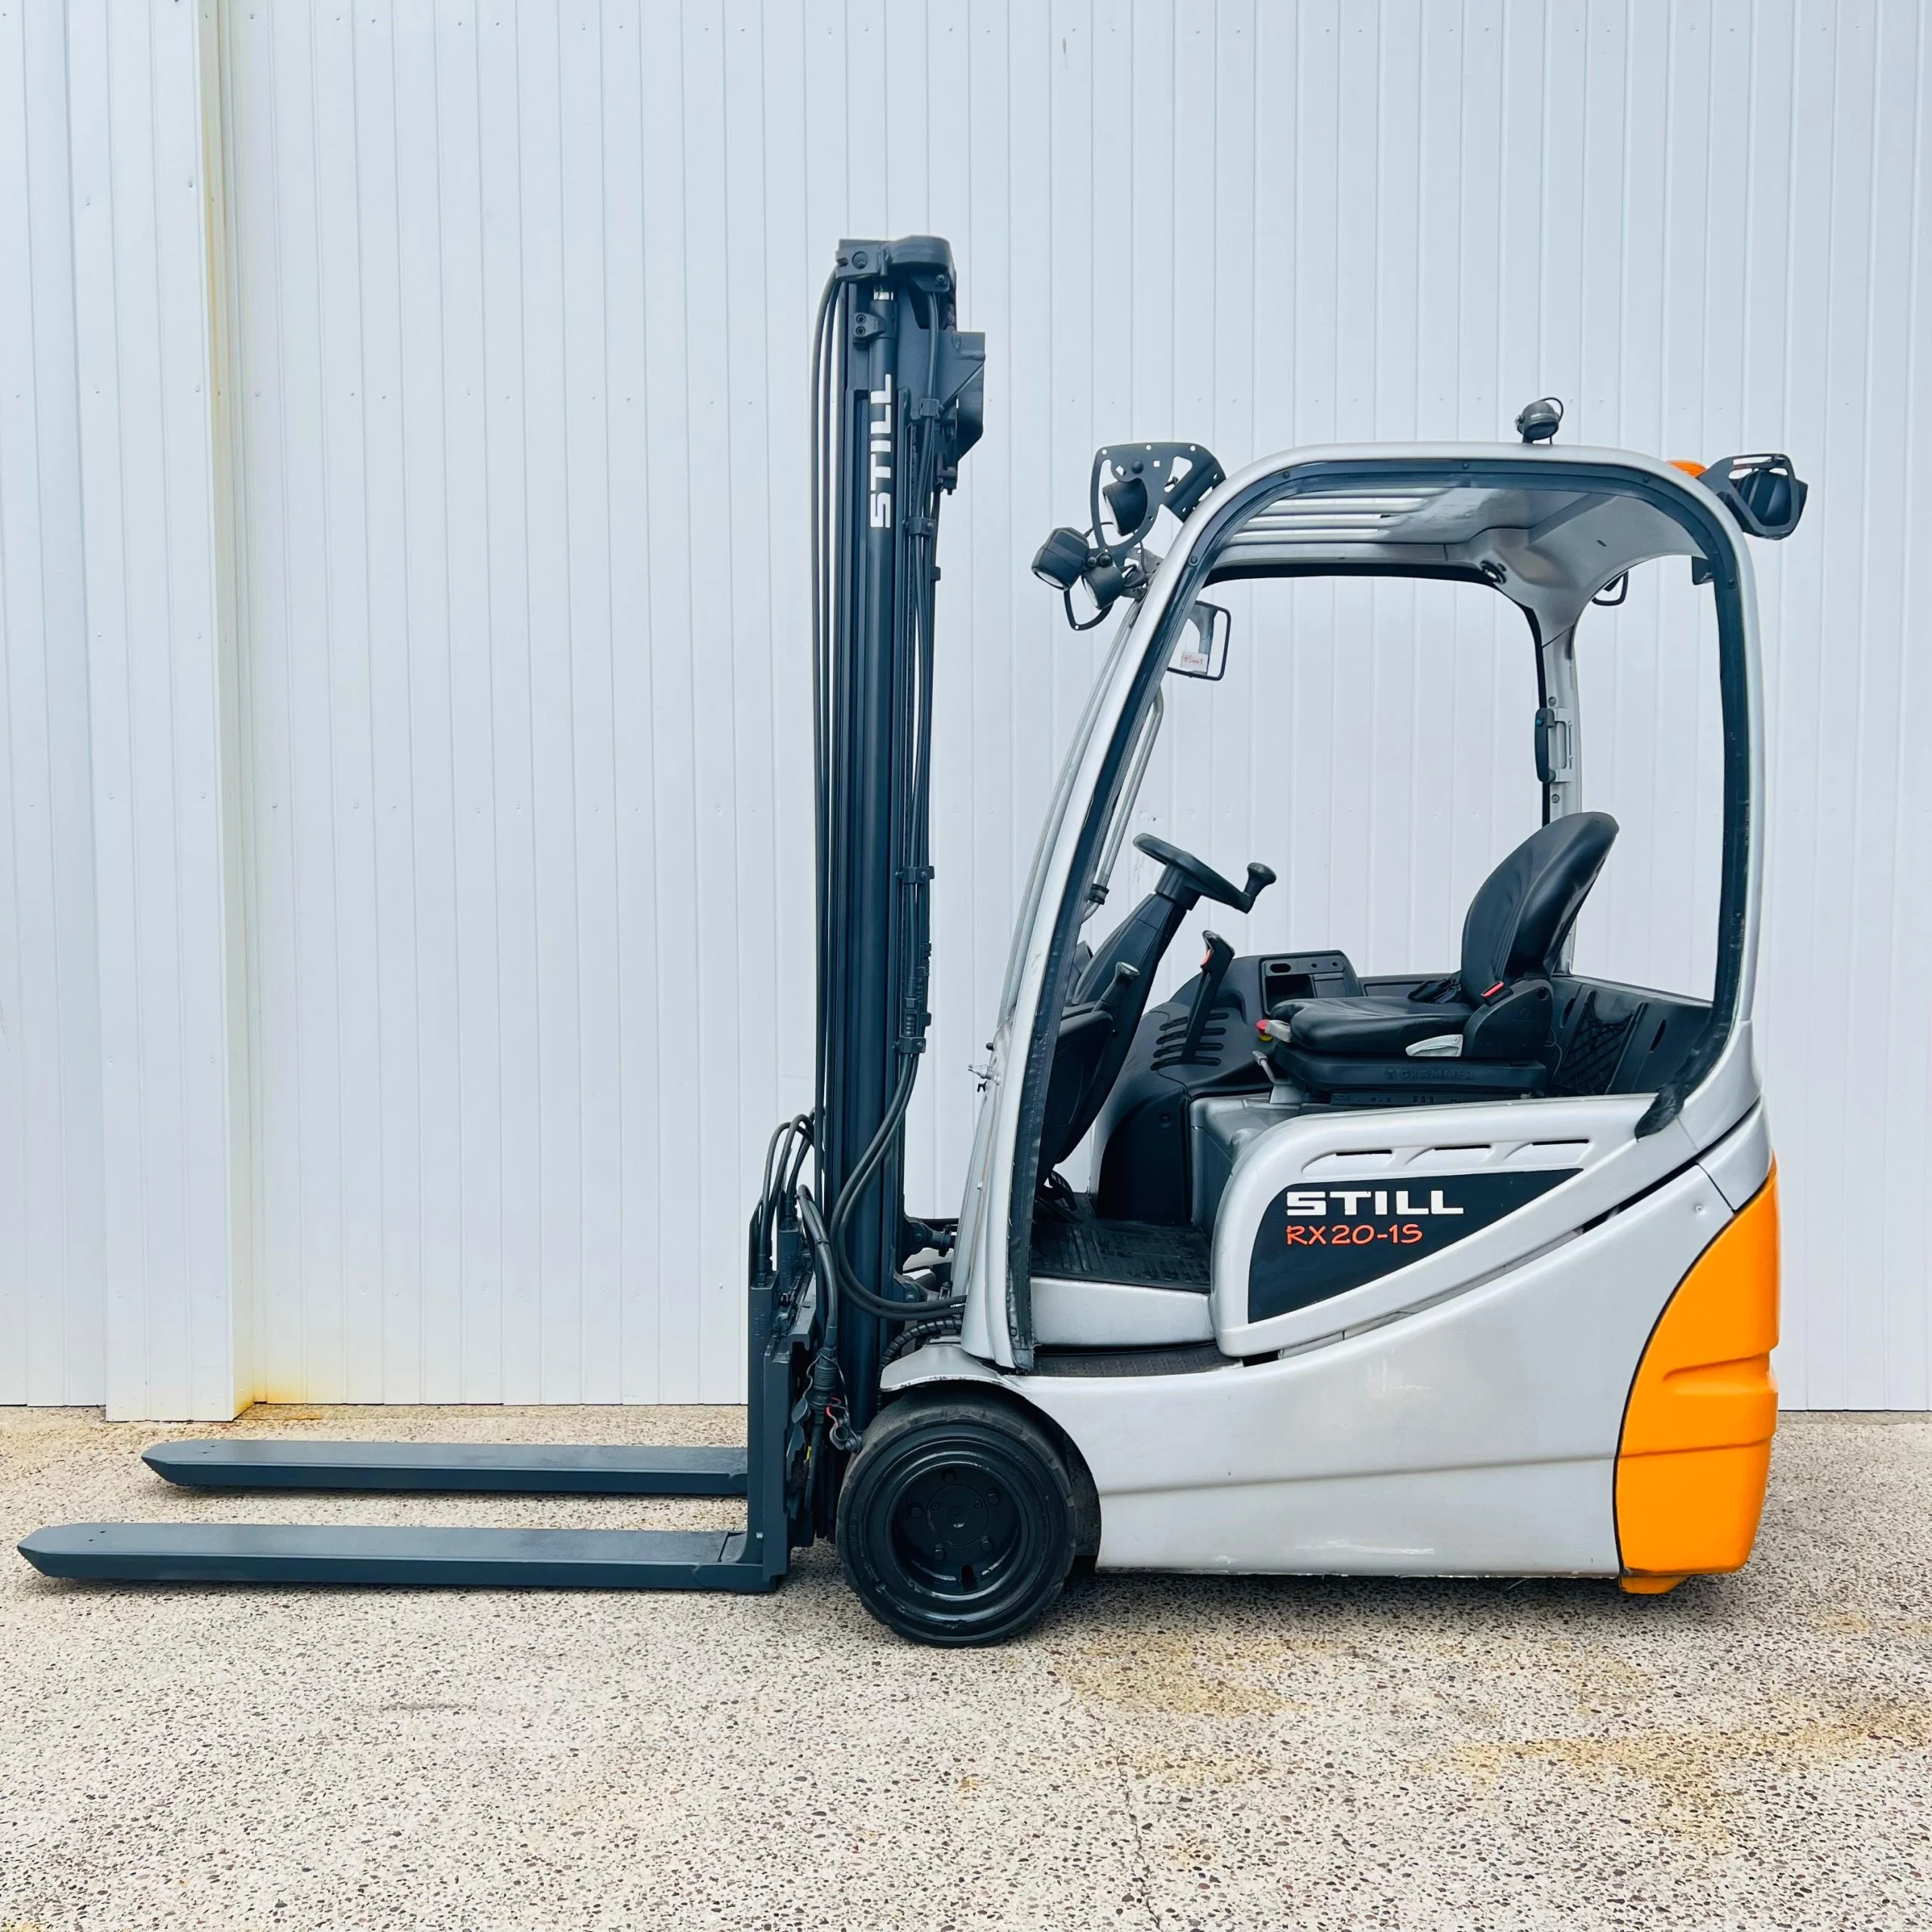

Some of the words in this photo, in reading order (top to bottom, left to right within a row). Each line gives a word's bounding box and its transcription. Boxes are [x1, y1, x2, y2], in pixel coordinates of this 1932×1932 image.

[870, 374, 891, 528] STILL
[1399, 1068, 1474, 1080] GRAMMER
[1286, 1190, 1464, 1216] STILL
